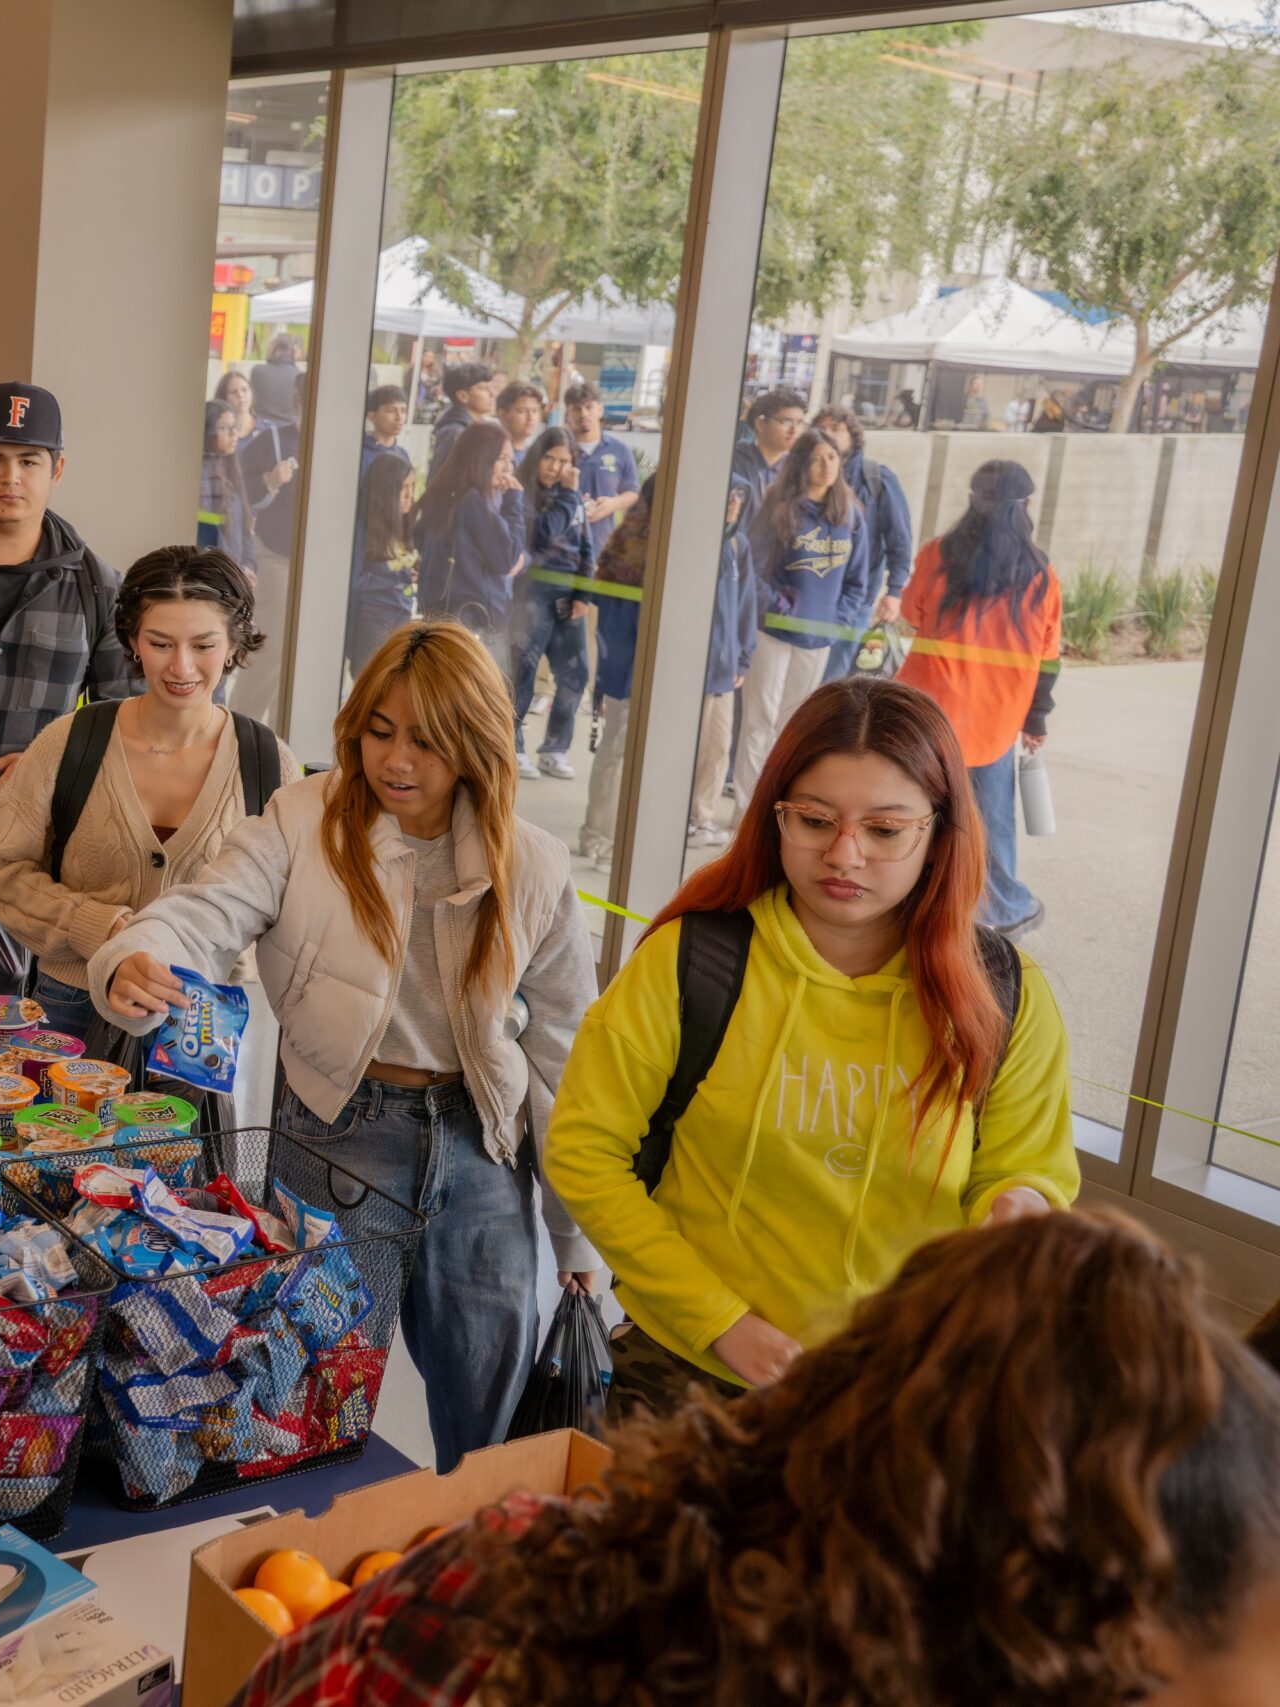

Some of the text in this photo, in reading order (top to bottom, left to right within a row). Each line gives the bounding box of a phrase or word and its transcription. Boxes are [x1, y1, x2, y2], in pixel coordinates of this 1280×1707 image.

[10, 396, 30, 428] F
[180, 989, 203, 1059] OREO
[139, 1130, 176, 1138] RICE
